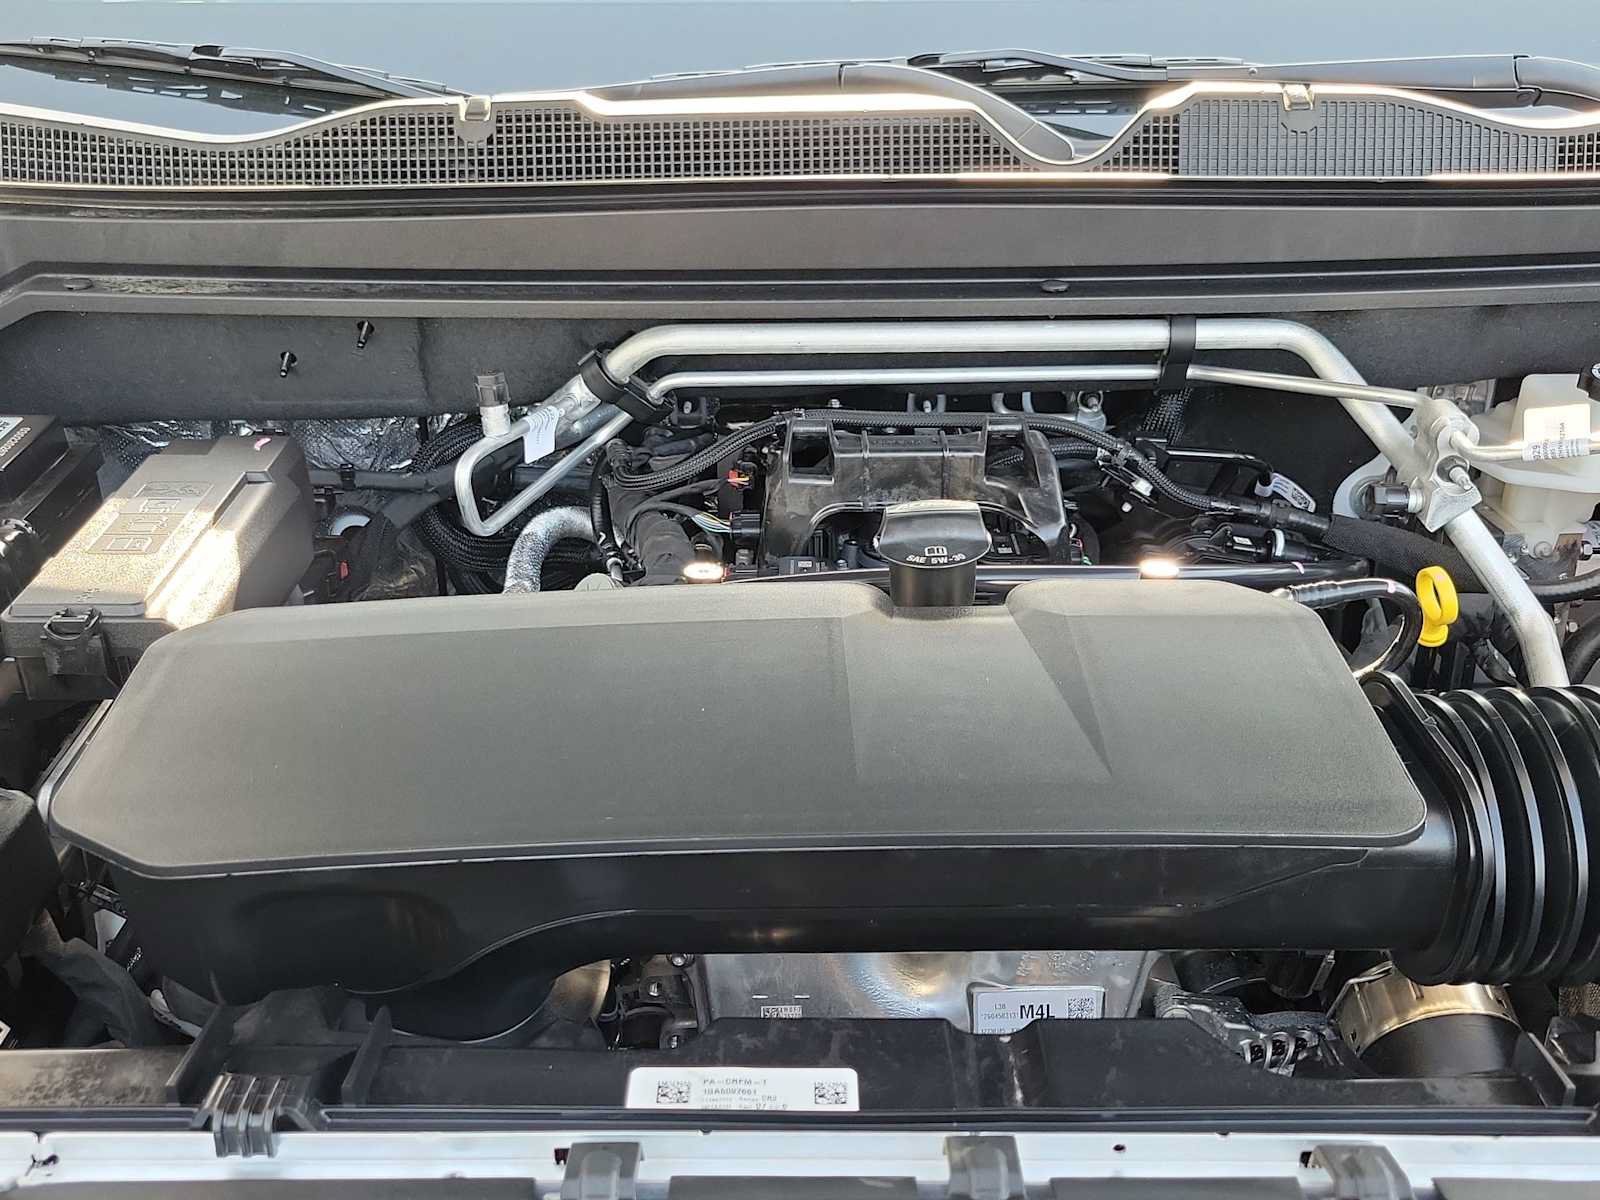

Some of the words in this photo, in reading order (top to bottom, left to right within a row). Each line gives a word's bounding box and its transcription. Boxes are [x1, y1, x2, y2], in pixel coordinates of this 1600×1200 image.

[906, 554, 927, 564] SAE
[931, 553, 966, 564] 5W-30
[1020, 1004, 1056, 1020] M4L
